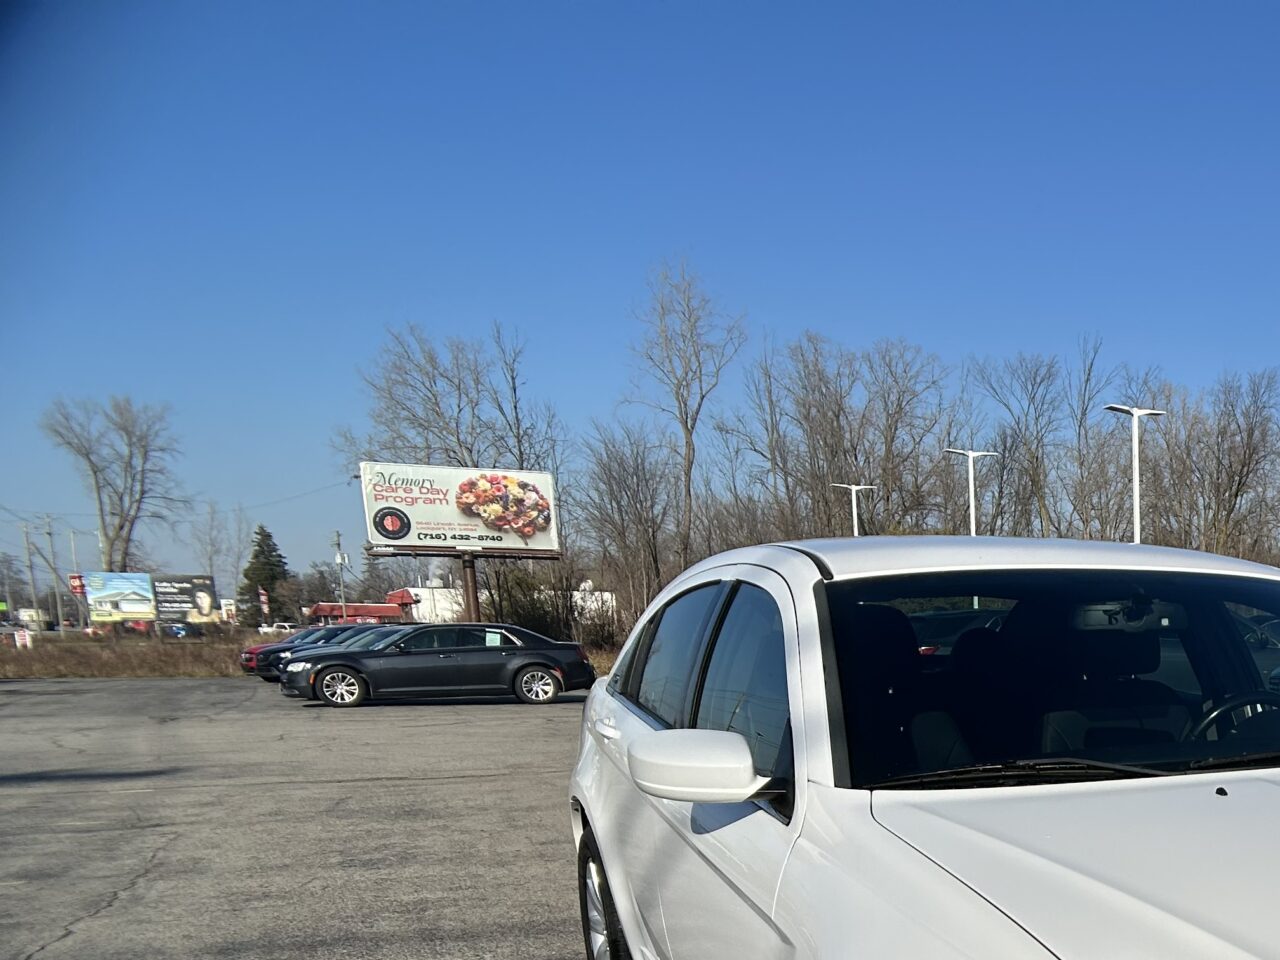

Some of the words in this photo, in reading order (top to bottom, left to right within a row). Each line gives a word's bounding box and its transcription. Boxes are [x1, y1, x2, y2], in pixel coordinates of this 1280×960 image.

[375, 471, 435, 488] Memory
[373, 483, 413, 494] Care
[419, 486, 449, 497] Day
[374, 494, 449, 506] Program
[417, 532, 447, 541] (716)
[450, 534, 503, 542] 432-8740
